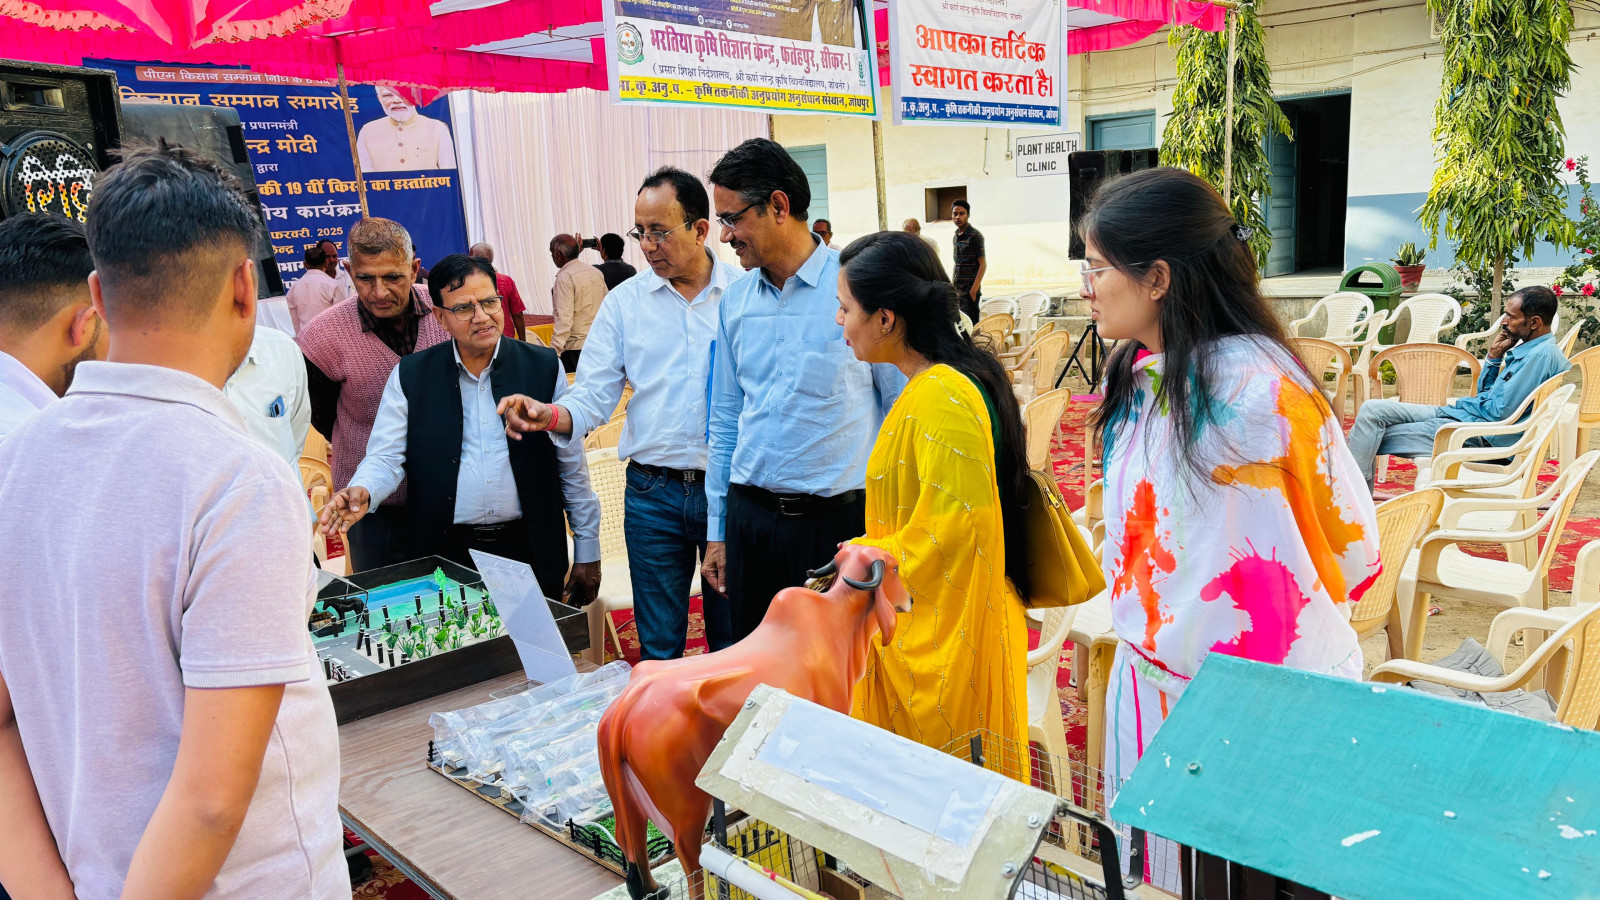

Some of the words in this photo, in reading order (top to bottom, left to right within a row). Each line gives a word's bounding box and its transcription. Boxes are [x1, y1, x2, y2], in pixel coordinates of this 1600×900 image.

[650, 25, 692, 53] भरतिया
[694, 30, 718, 62] कृषि
[718, 32, 751, 60] विज्ञान
[780, 41, 819, 74] फतेहपुर,
[915, 24, 987, 56] आपका
[990, 30, 1046, 63] हार्दिक
[143, 69, 176, 80] पीएम
[179, 69, 218, 81] किसान
[222, 73, 261, 82] सम्मान
[658, 64, 676, 75] प्रसार
[678, 64, 696, 79] शिक्षा
[736, 70, 744, 81] श्री
[775, 74, 788, 87] कृषि
[909, 64, 978, 91] स्वागत
[982, 71, 1033, 96] करता
[1035, 68, 1053, 97] है।
[209, 93, 279, 109] सम्मान
[286, 91, 359, 113] समारोह
[694, 83, 713, 99] कृषि
[714, 85, 750, 99] तकनीकी
[751, 88, 787, 105] अनुप्रयोग
[788, 91, 820, 106] अनुसंधान
[848, 94, 870, 111] जोधपुर
[945, 101, 957, 117] कृषि
[958, 102, 980, 115] तकनीकी
[1006, 105, 1027, 120] अनुसंधान
[249, 118, 298, 130] प्रधानमंत्री
[276, 134, 318, 153] मोदी
[1018, 143, 1042, 156] PLANT
[1045, 140, 1077, 153] HEALTH
[256, 163, 278, 174] द्वारा
[1026, 161, 1057, 172] CLINIC
[256, 180, 282, 195] की
[285, 182, 302, 195] 19
[305, 179, 325, 194] वीं
[369, 180, 391, 191] का
[392, 174, 451, 191] हस्तांतरण
[295, 199, 362, 218] कार्यक्रम
[317, 227, 344, 237] 2025
